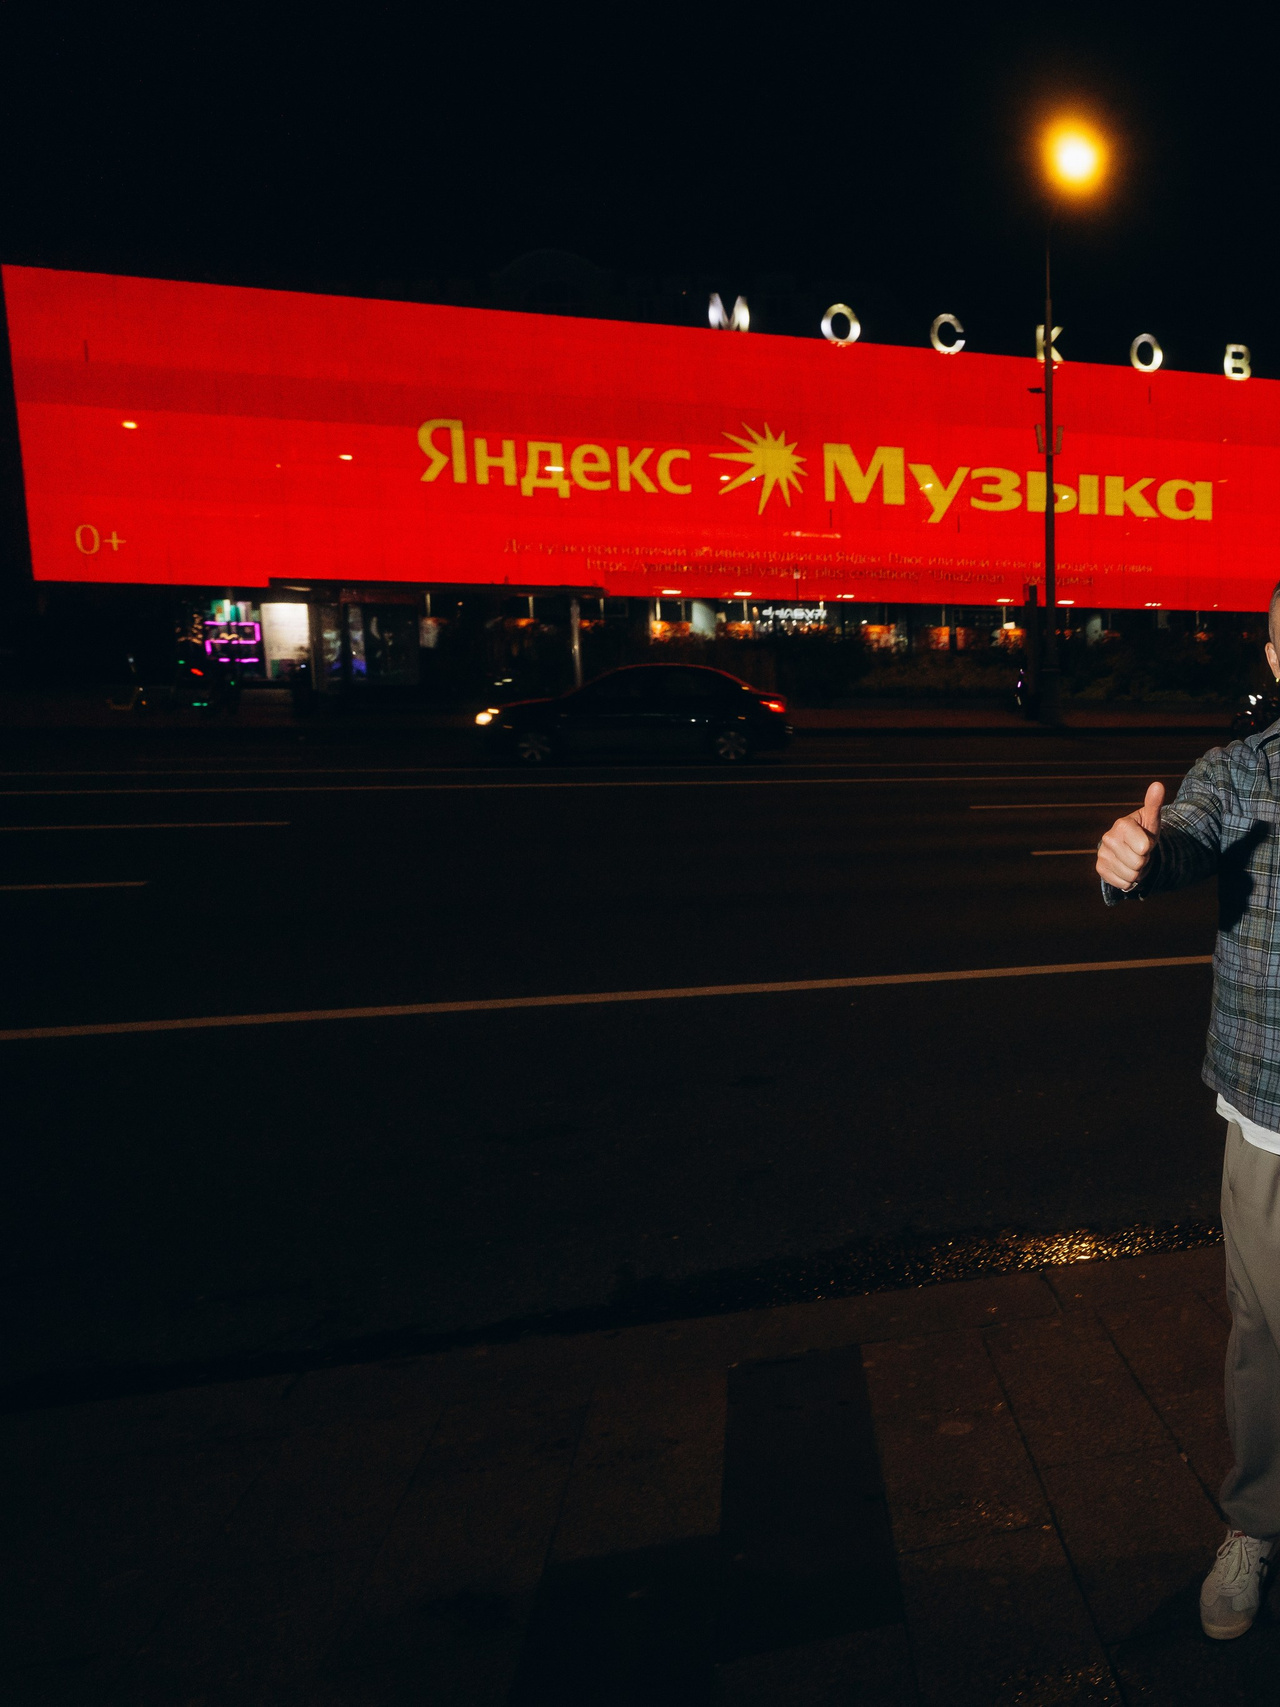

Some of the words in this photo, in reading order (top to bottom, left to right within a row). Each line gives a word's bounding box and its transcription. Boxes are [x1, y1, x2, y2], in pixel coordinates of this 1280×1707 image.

[417, 418, 693, 498] Яндекс
[823, 443, 1213, 524] Музыка
[74, 523, 127, 555] 0+
